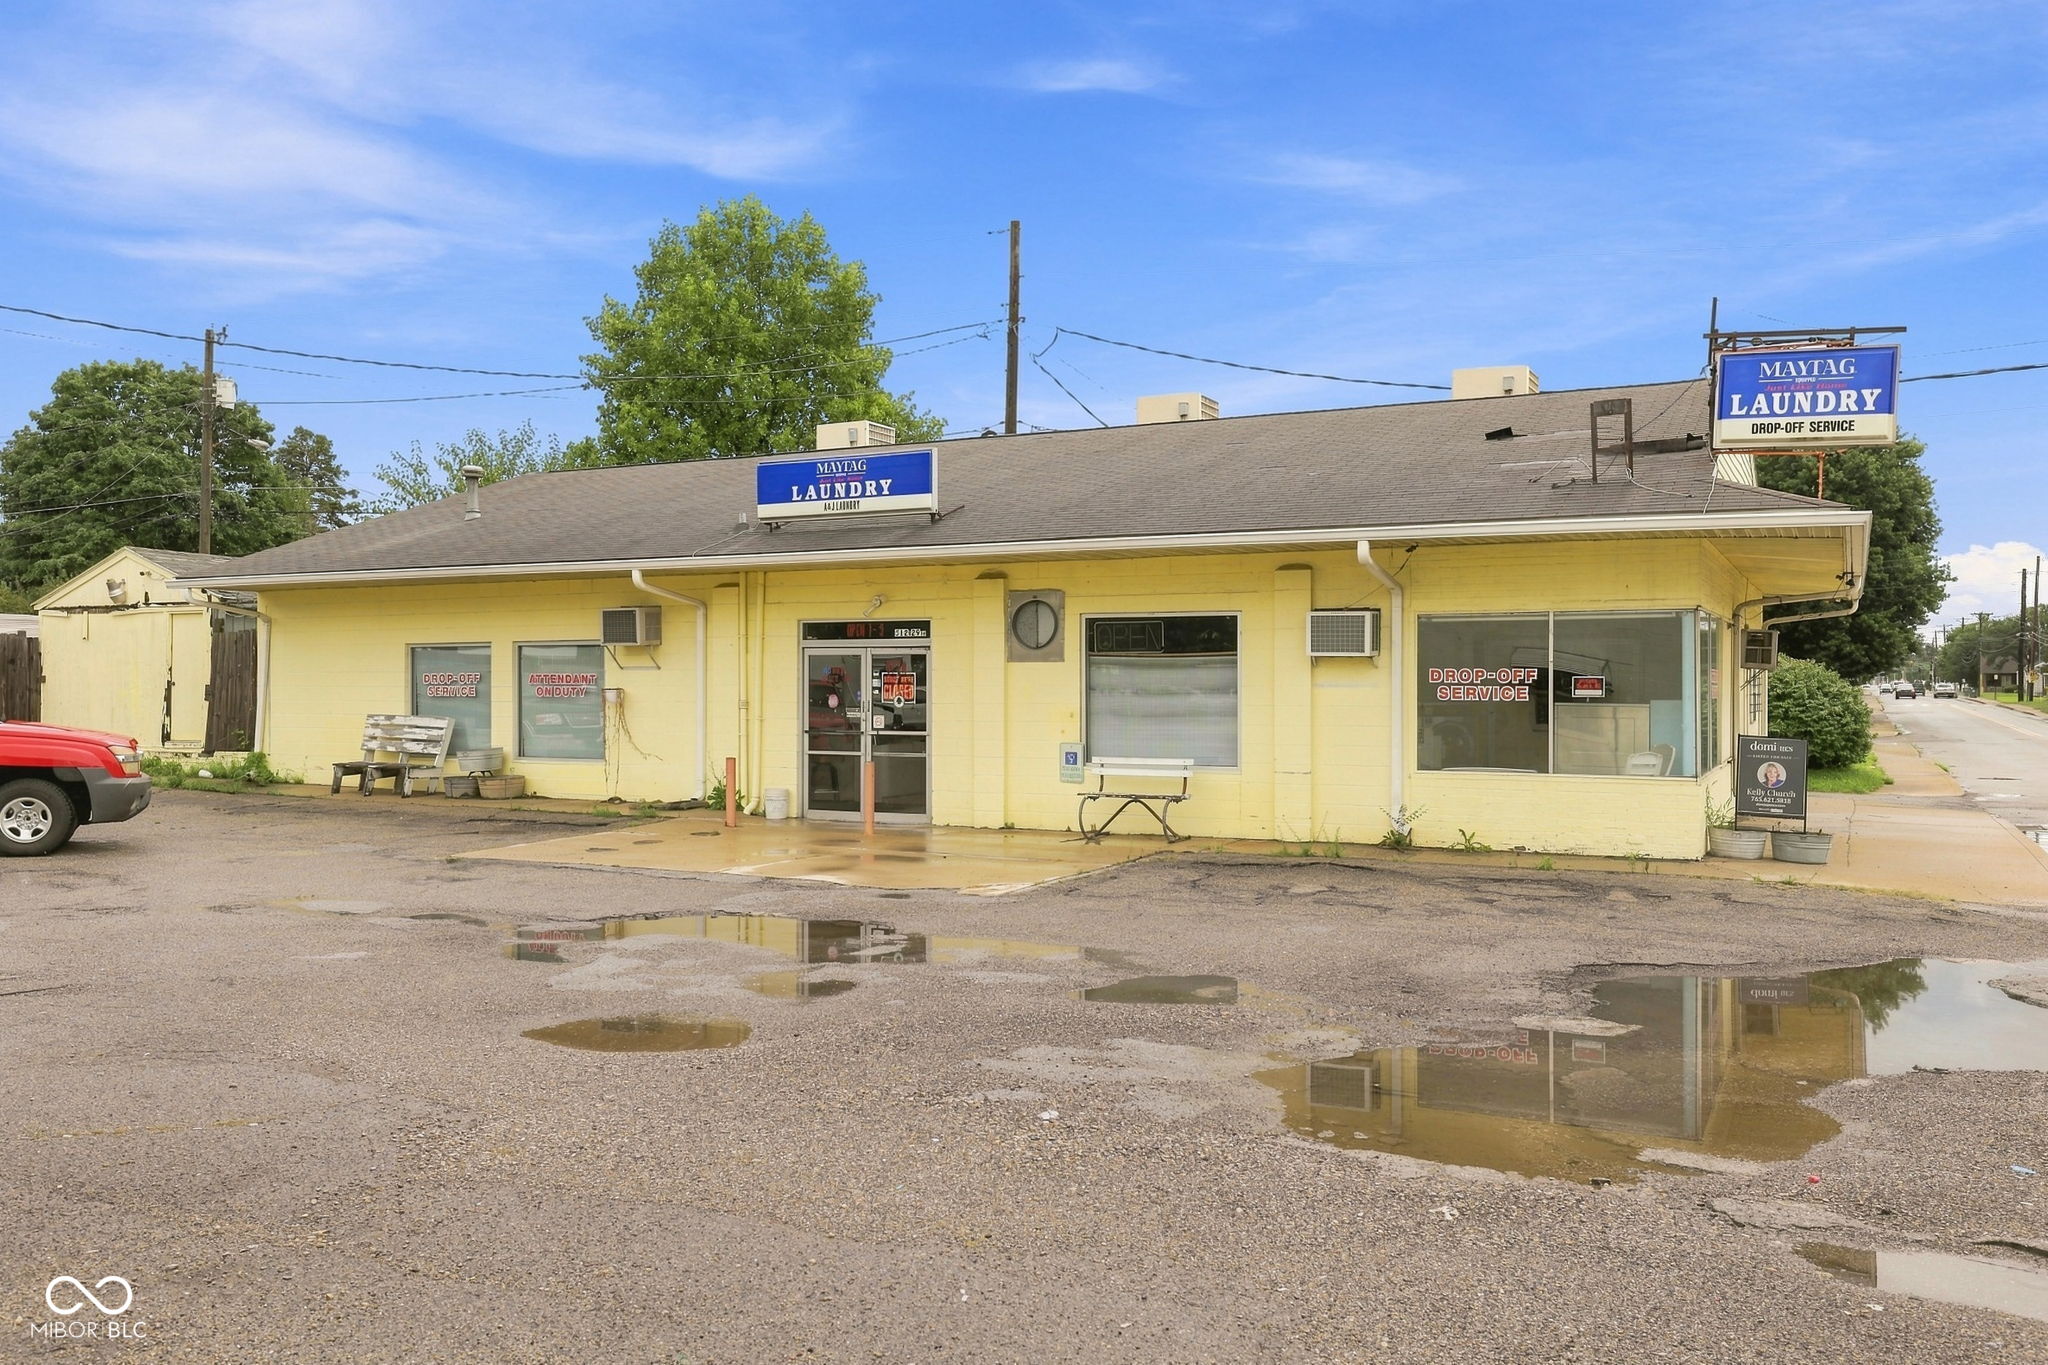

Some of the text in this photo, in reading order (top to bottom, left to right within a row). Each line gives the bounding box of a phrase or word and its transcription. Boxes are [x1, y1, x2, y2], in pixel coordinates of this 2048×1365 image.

[1759, 358, 1855, 377] MAYTAG
[1730, 388, 1882, 415] LAUNDRY
[1751, 420, 1855, 434] DROP-OFF SERVICE
[816, 459, 867, 474] MAYTAG
[792, 479, 892, 501] LAUNDRY
[1099, 623, 1161, 650] OPEN
[423, 672, 481, 685] DROP-OFF
[528, 672, 597, 685] ATTENDANT
[1429, 668, 1538, 684] DROP-OFF
[427, 685, 477, 697] SERVICE
[1437, 685, 1530, 702] SERVICE
[1750, 741, 1777, 751] domi
[1746, 788, 1796, 798] Kelly Church
